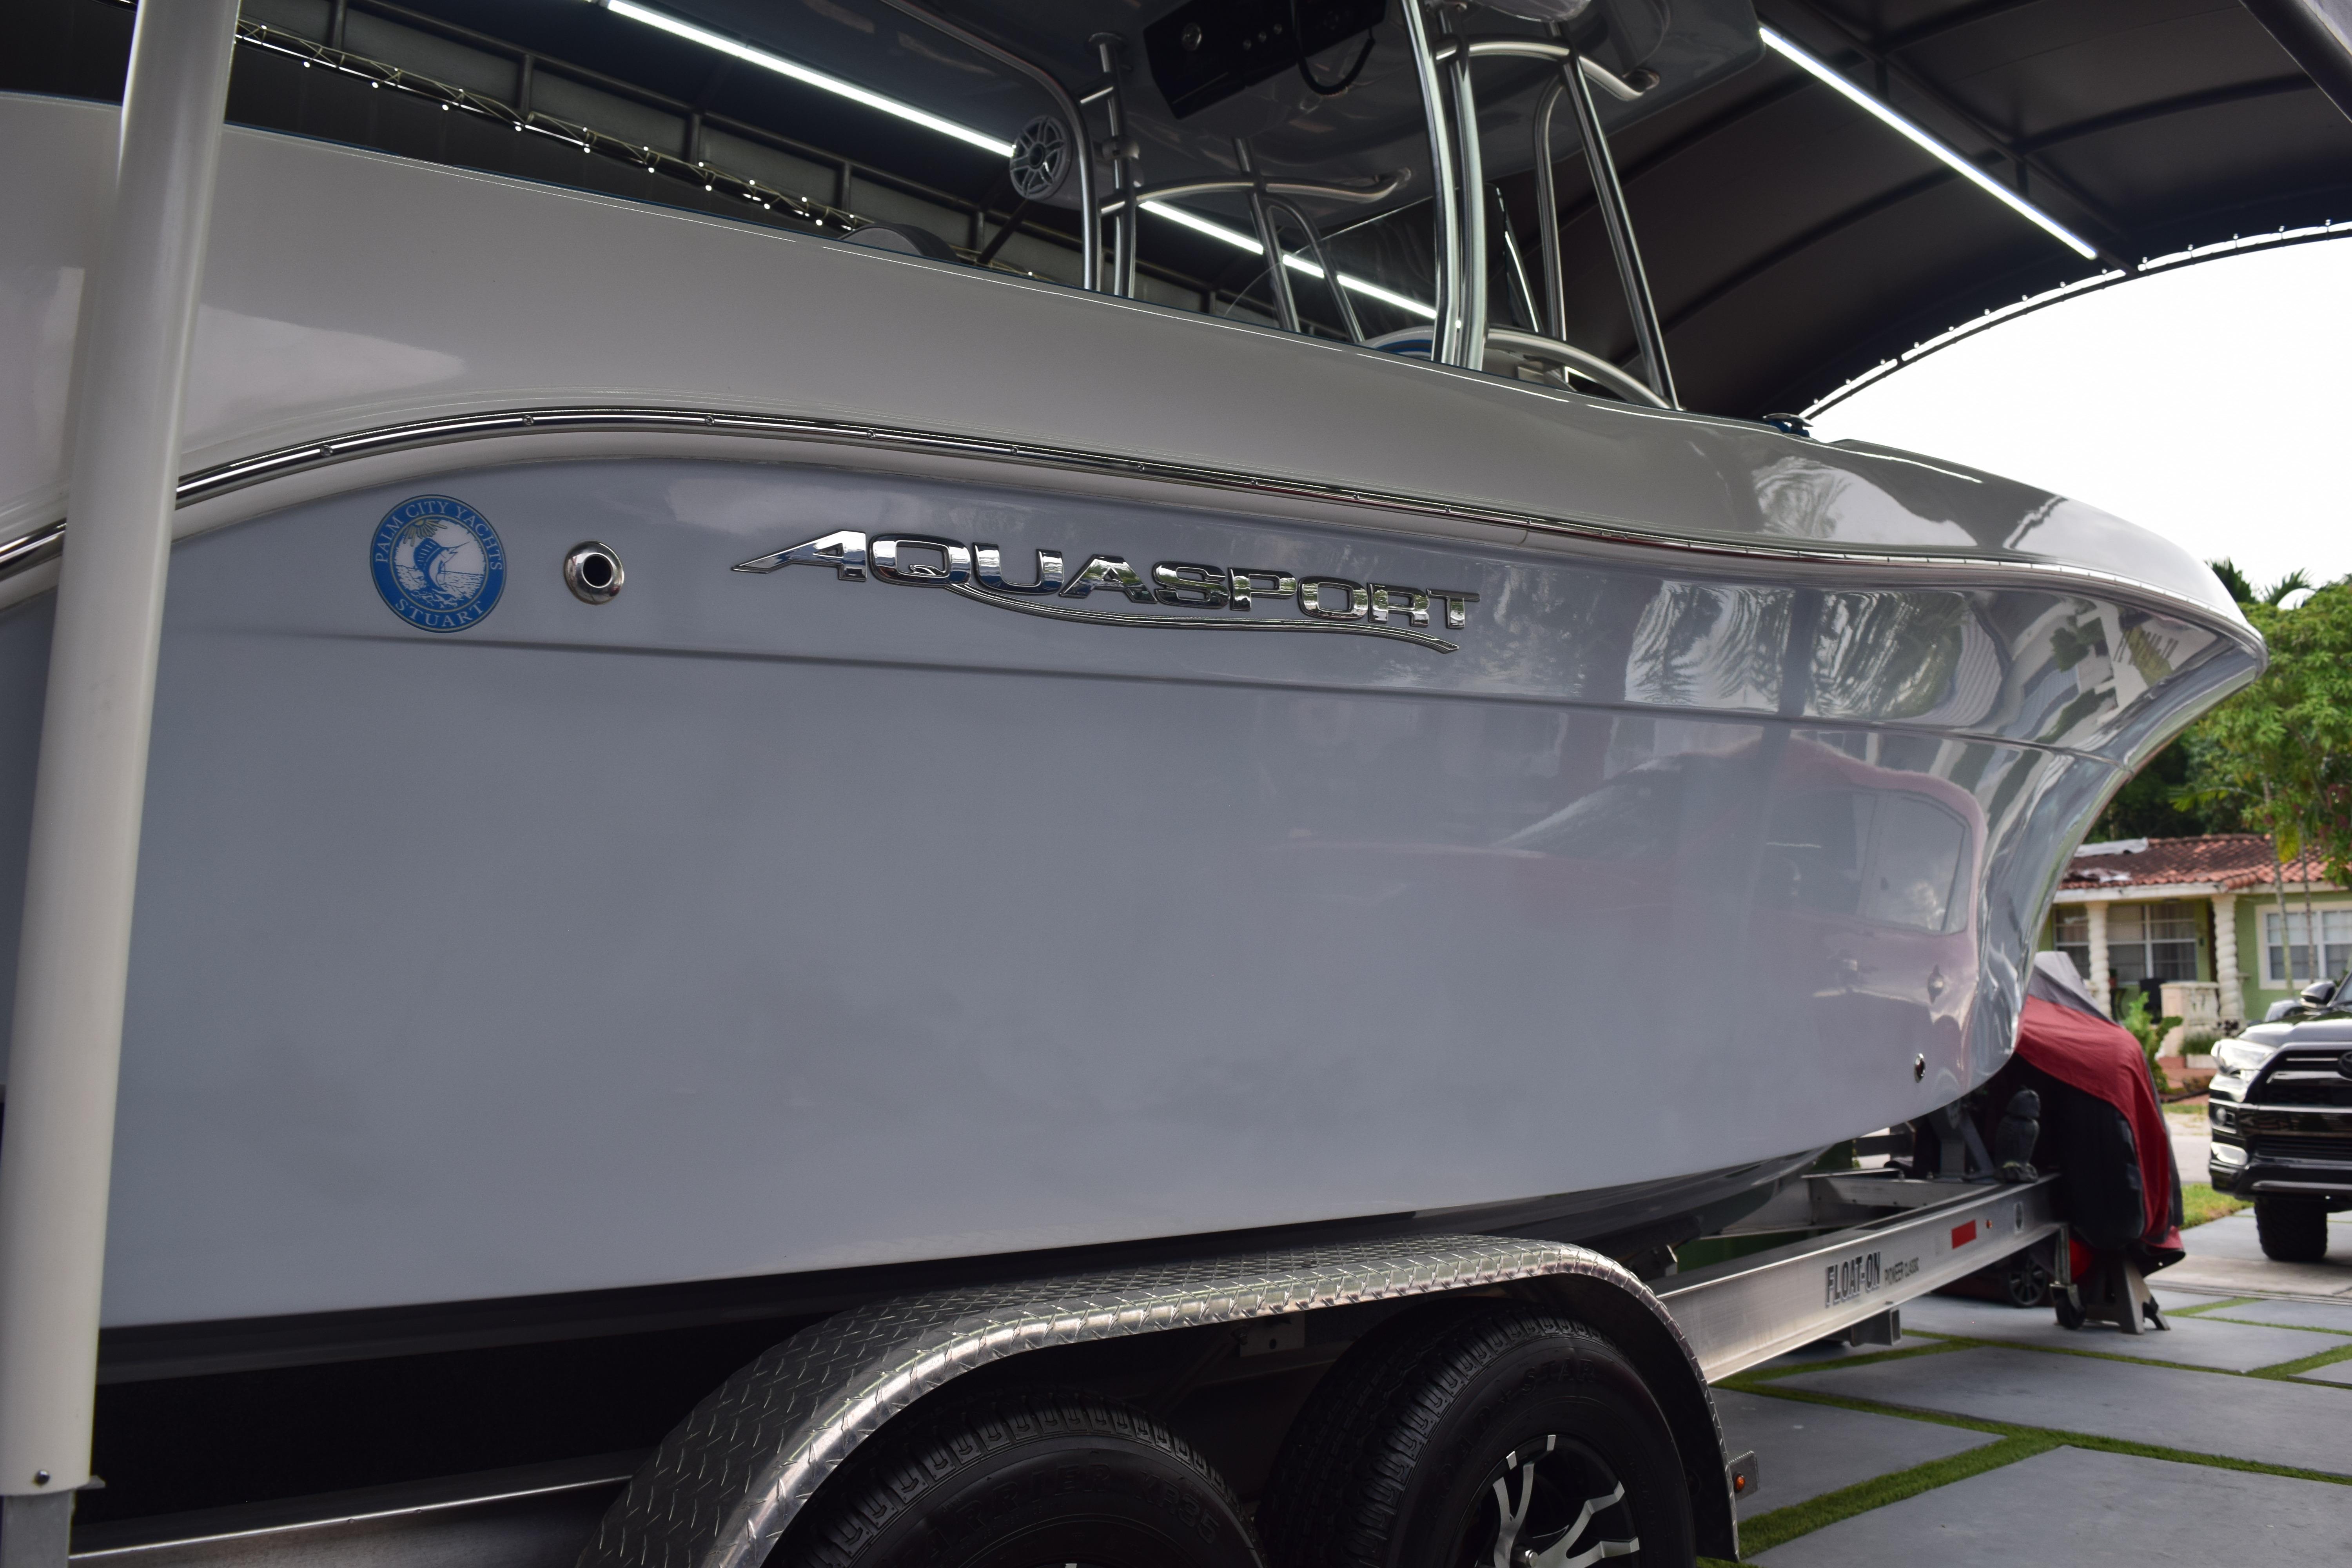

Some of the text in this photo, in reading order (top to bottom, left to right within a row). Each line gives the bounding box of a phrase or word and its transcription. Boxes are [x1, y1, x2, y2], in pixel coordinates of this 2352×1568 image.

[375, 501, 503, 570] PALM CITY YACHTS
[395, 599, 484, 627] STUART
[731, 530, 1479, 643] AQUASPORT
[1826, 1251, 1881, 1308] FLOAT-ON
[1520, 1358, 1597, 1394] STAR
